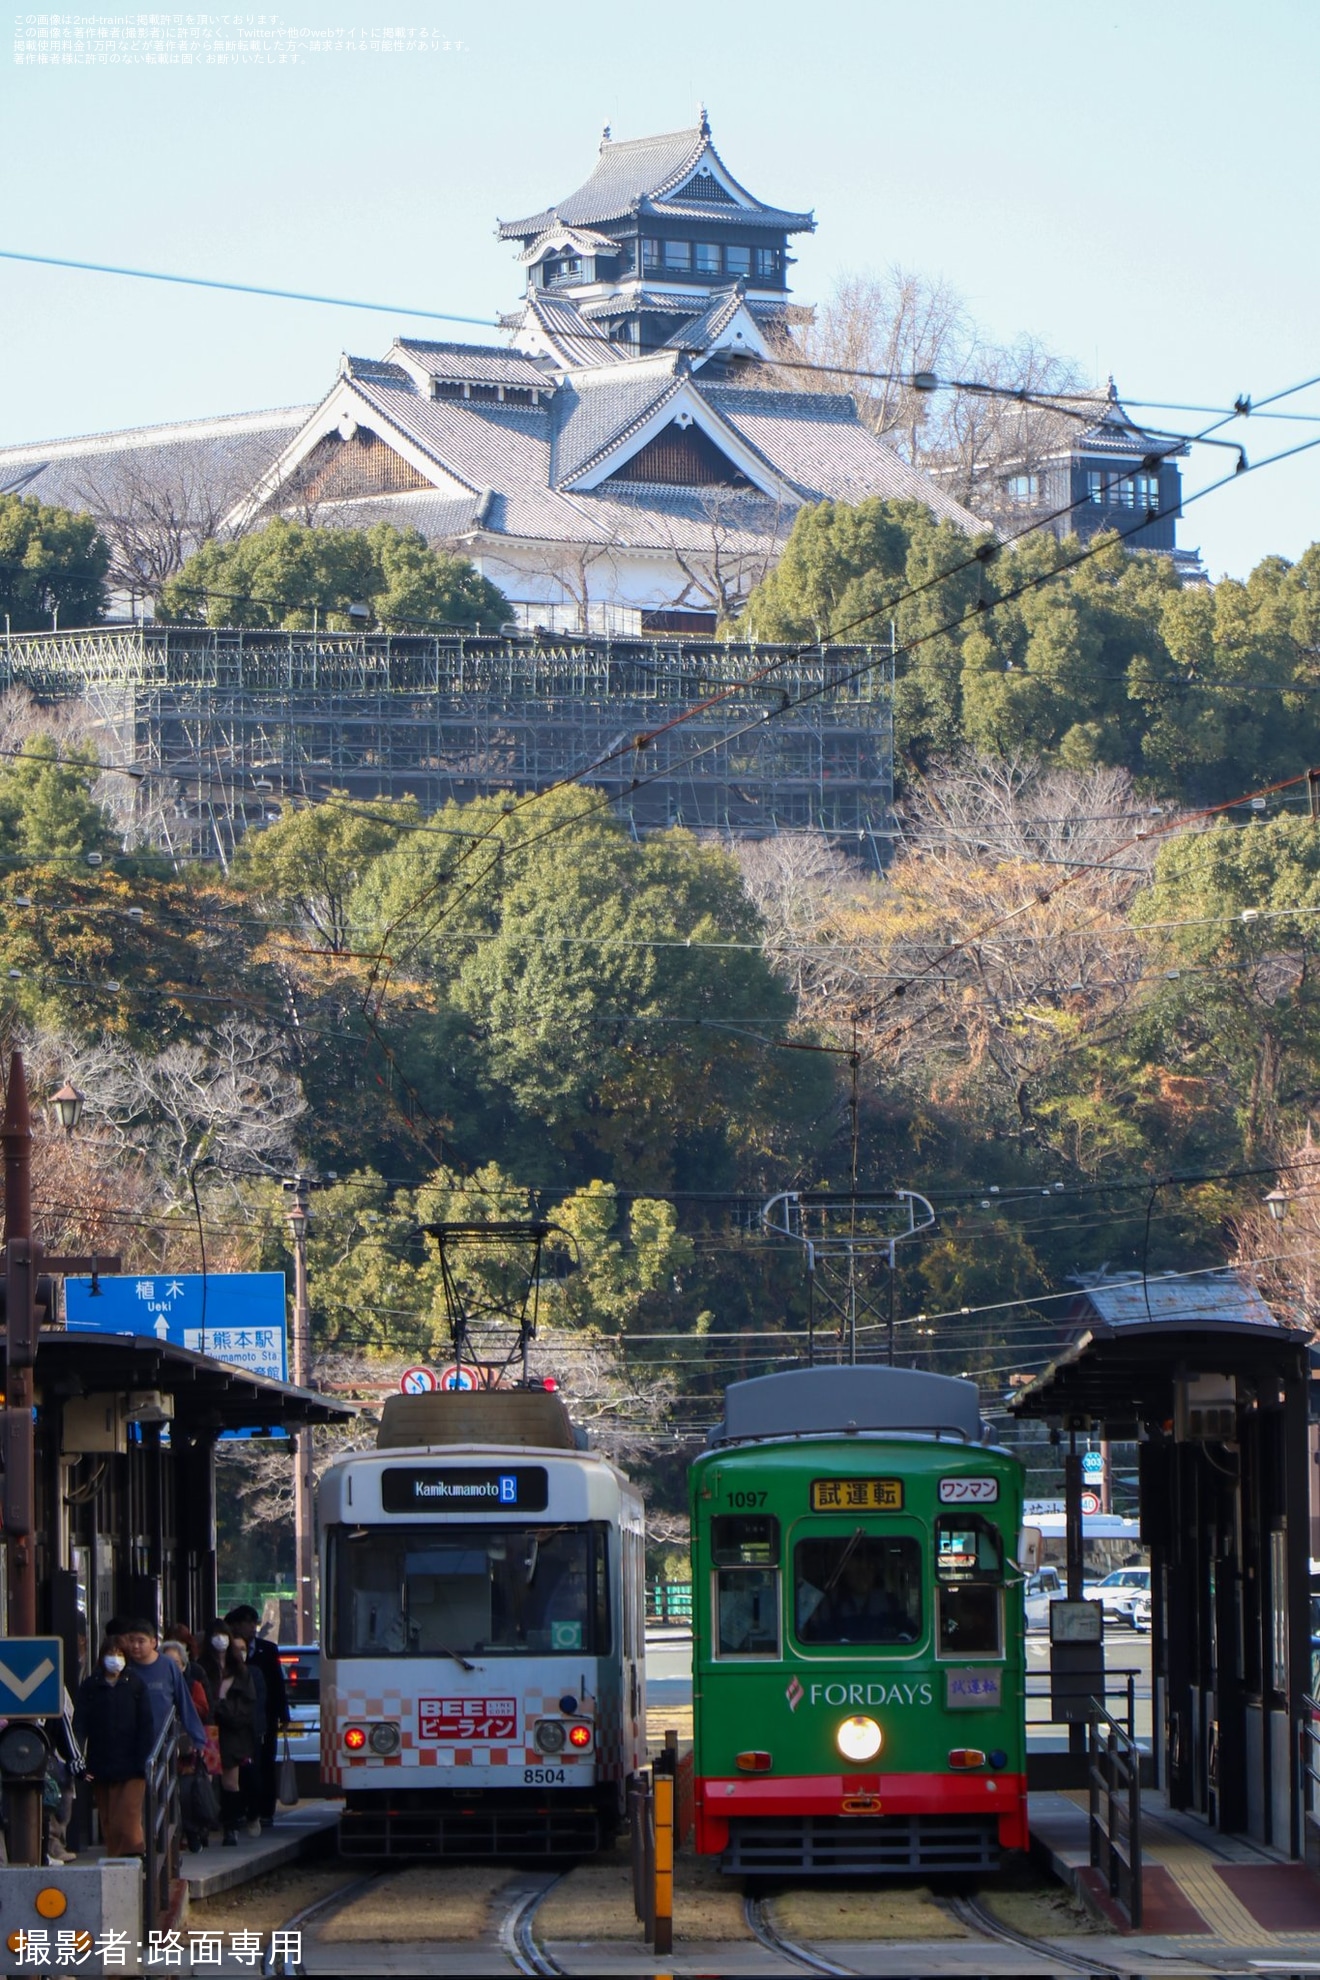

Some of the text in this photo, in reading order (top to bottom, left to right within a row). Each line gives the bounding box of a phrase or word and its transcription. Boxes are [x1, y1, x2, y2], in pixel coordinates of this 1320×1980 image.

[136, 1280, 185, 1300] 植木
[147, 1301, 172, 1312] Ueki
[193, 1330, 275, 1350] 上熊本駅
[1085, 1458, 1103, 1468] 303
[415, 1479, 515, 1500] Kamikumamoto B
[819, 1482, 896, 1506] 試運転
[941, 1482, 996, 1498] ワンマン
[727, 1491, 767, 1507] 1097
[1083, 1499, 1095, 1510] 40
[811, 1684, 933, 1705] FORDAYS
[420, 1700, 484, 1717] BEE
[422, 1718, 514, 1738] ビーライン
[524, 1770, 565, 1784] 8504
